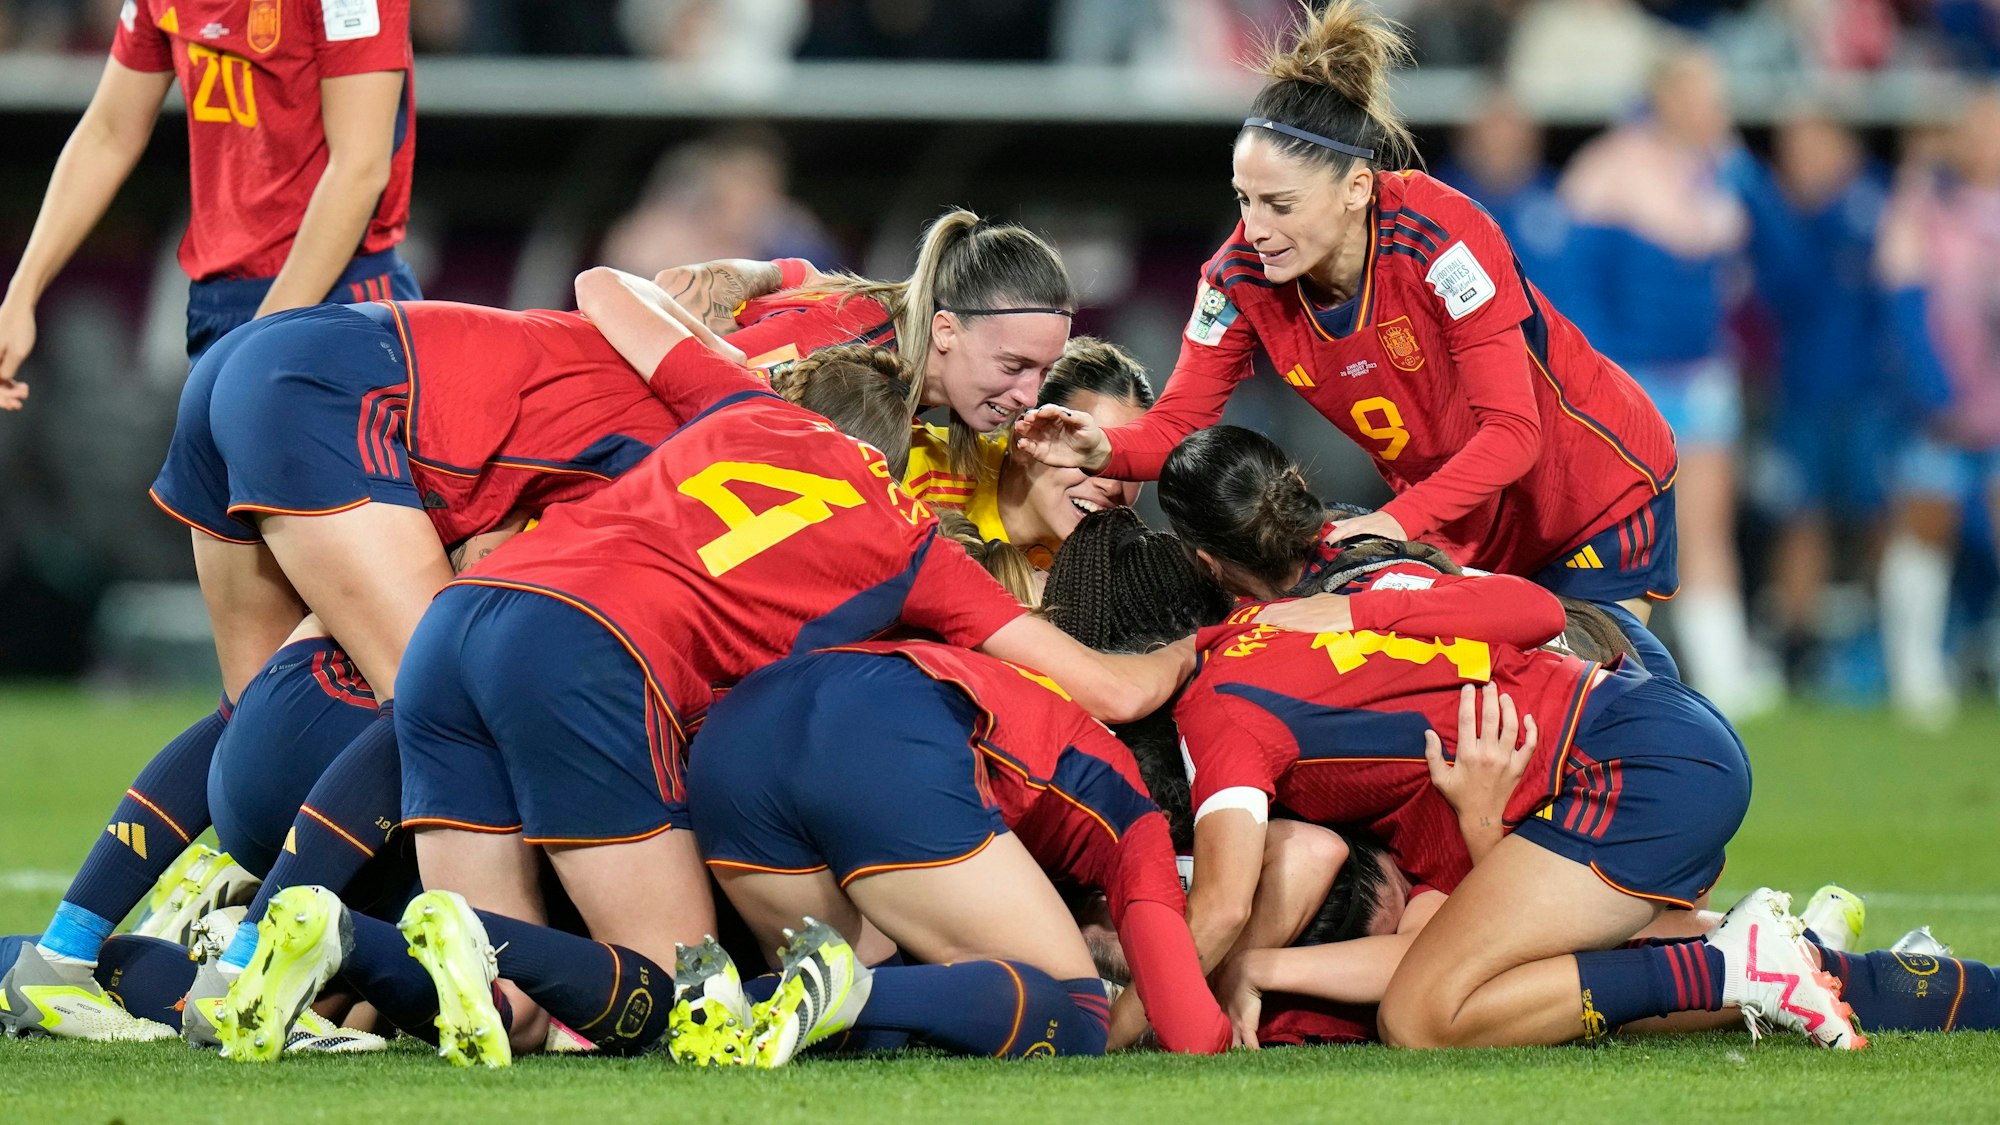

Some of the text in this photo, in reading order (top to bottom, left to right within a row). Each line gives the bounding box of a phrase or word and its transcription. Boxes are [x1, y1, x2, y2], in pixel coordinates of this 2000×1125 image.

[187, 42, 258, 128] 20
[1441, 264, 1470, 290] UNITES
[1350, 396, 1411, 461] 9
[677, 461, 867, 578] 4
[374, 815, 391, 830] 19
[77, 1002, 102, 1014] PREDATOR
